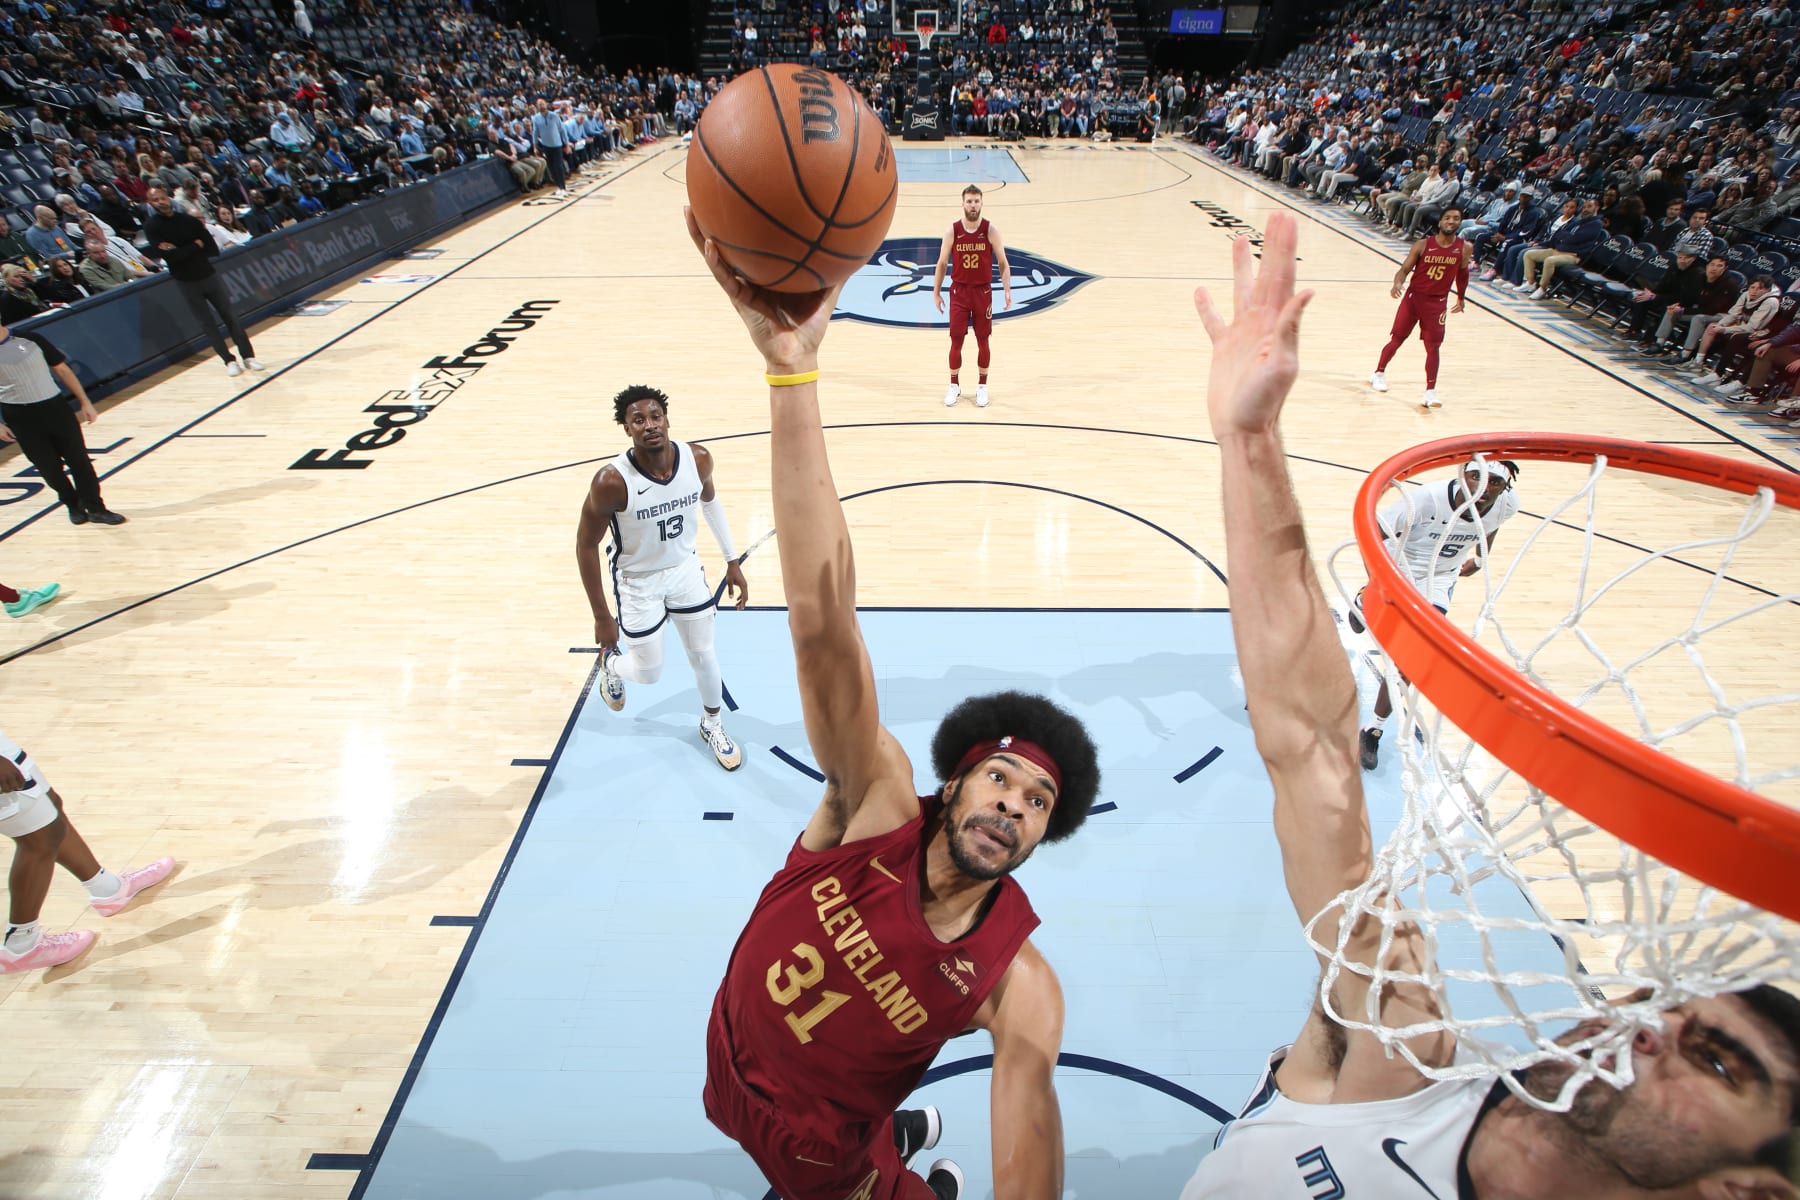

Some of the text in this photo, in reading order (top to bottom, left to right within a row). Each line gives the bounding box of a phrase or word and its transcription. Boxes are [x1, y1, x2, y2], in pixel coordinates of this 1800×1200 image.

[1178, 16, 1214, 33] cigna
[914, 117, 935, 125] SONIC
[304, 231, 350, 267] Bank
[343, 223, 380, 251] Easy
[956, 243, 986, 252] CLEVELAND
[963, 254, 979, 269] 32
[1424, 255, 1457, 265] CLEVELAND
[1427, 265, 1446, 280] 45
[287, 300, 560, 470] FedExForum
[636, 491, 698, 520] MEMPHIS
[656, 514, 684, 541] 13
[811, 875, 928, 1034] CLEVELAND
[940, 962, 970, 995] CLIFFS
[766, 942, 852, 1045] 31
